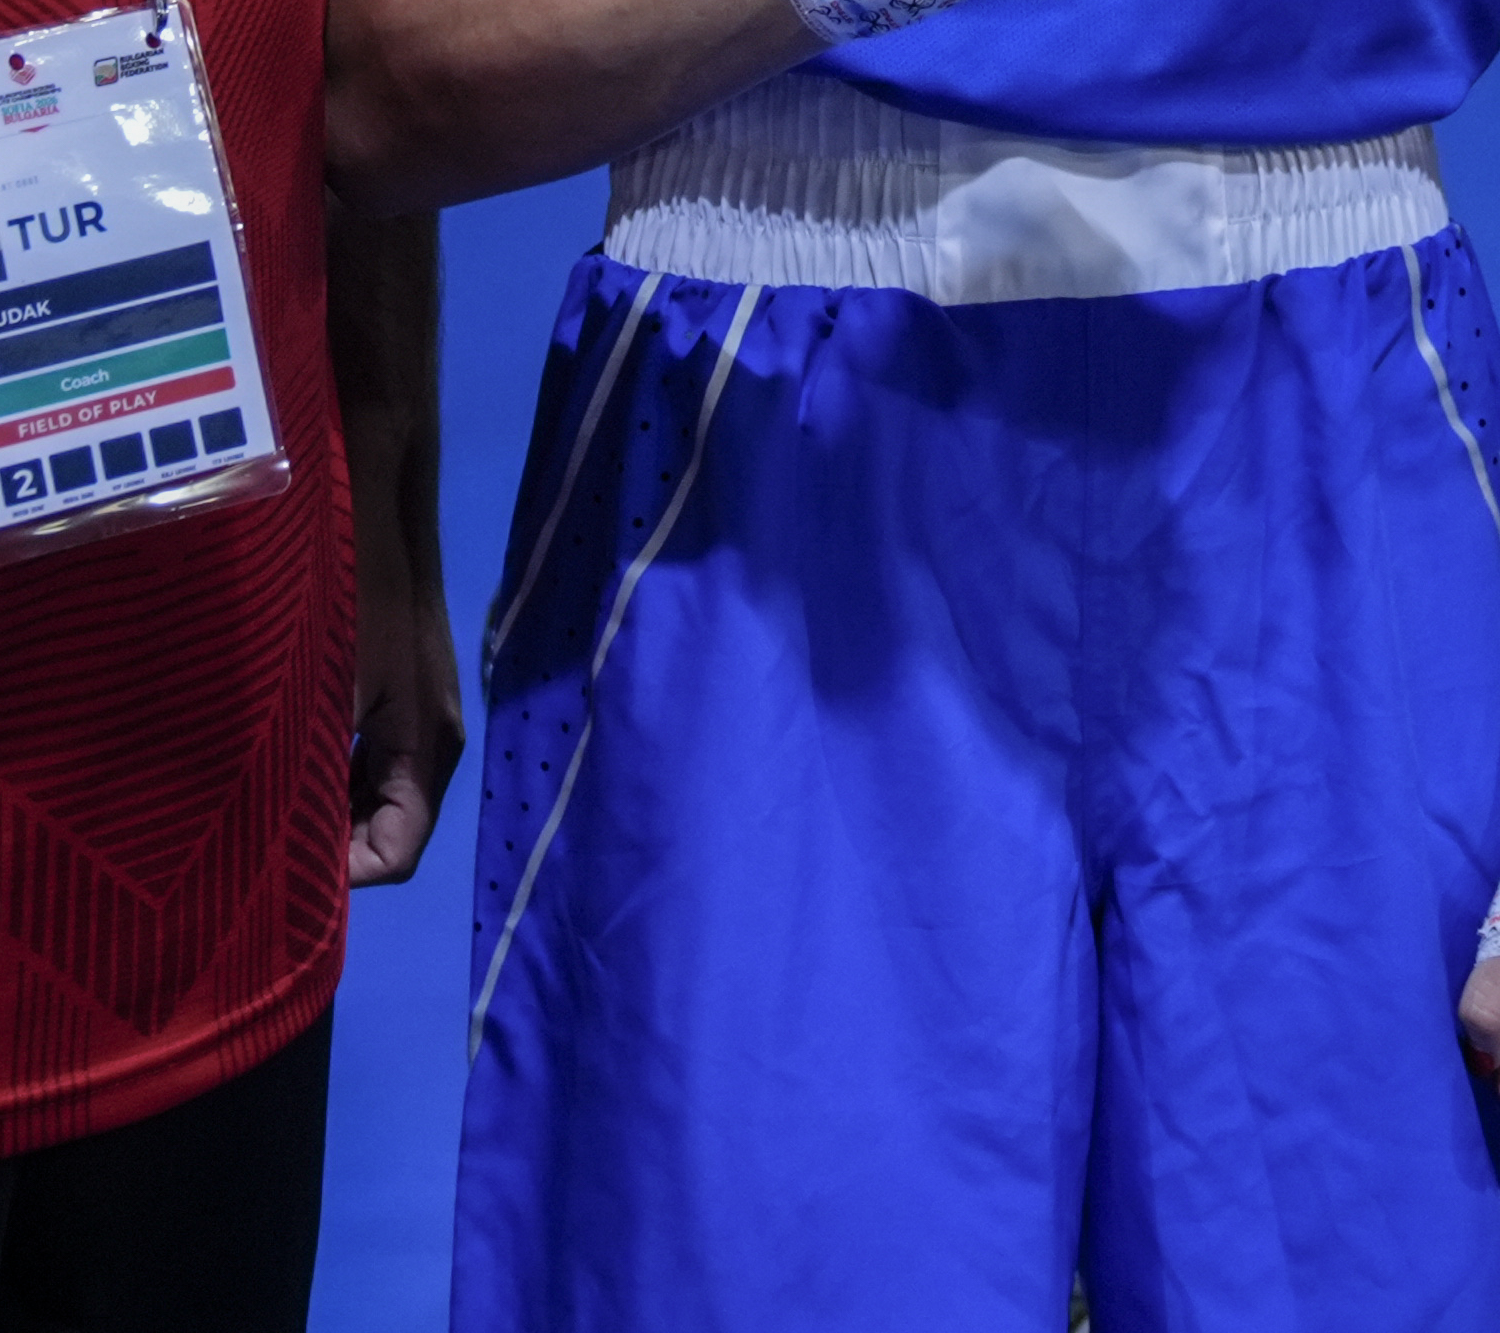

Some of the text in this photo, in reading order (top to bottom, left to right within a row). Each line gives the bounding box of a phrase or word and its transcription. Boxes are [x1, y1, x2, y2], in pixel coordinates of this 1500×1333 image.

[7, 200, 107, 251] TUR
[61, 369, 109, 392] Coach
[18, 390, 157, 438] FIELD OF PLAY
[12, 468, 37, 499] 2
